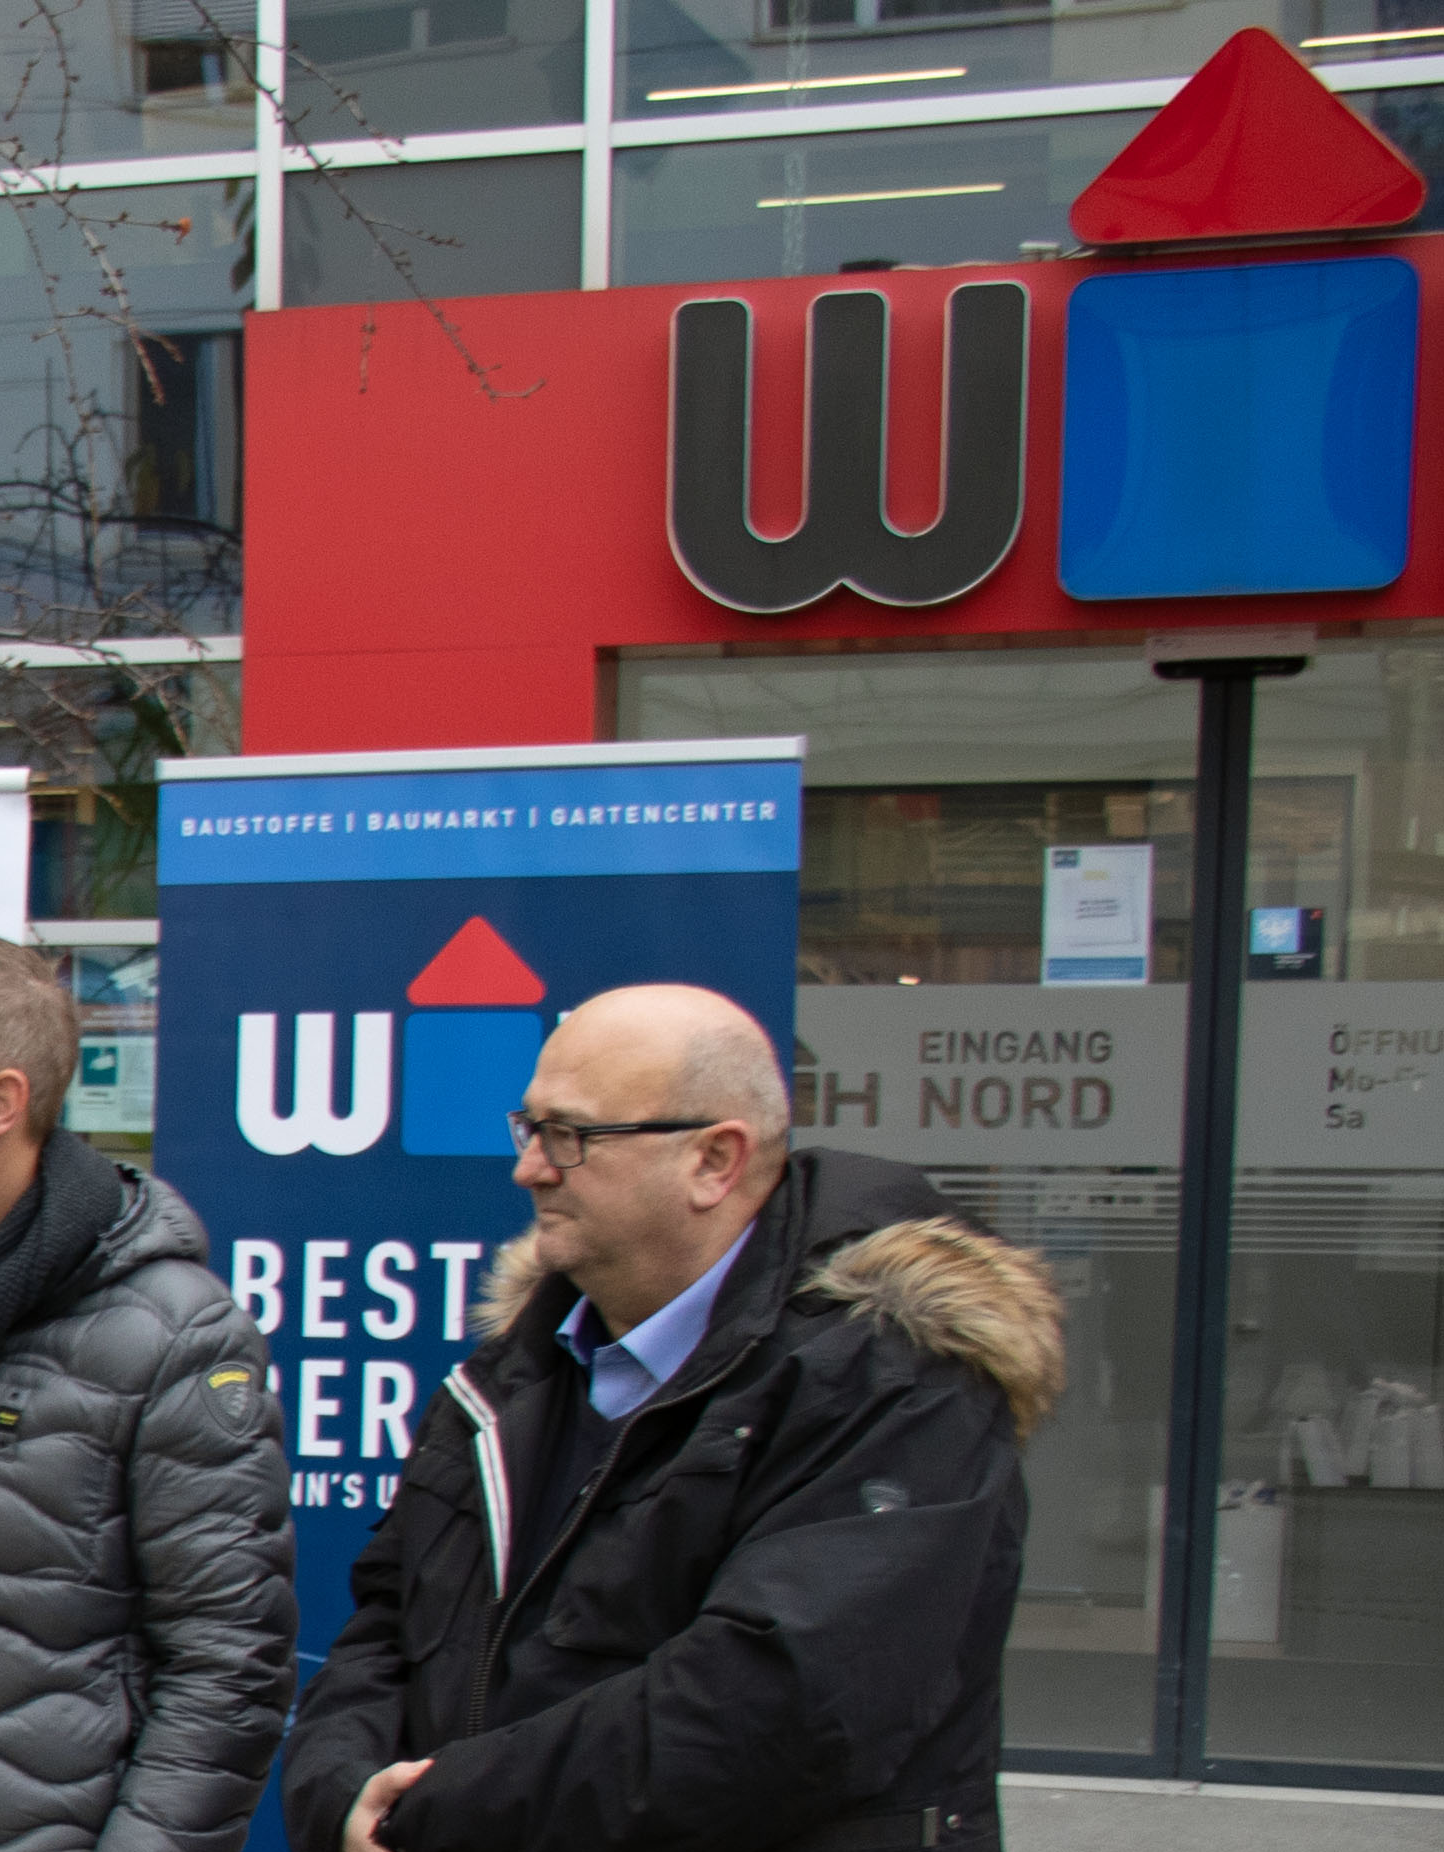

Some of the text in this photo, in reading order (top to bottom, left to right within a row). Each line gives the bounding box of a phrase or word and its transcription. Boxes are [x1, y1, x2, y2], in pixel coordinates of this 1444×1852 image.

[181, 801, 777, 837] BAUSTOFFE BAUMARKT GARTENCENTER
[918, 1029, 1114, 1065] EINGANG
[918, 1074, 1114, 1130] NORD
[1325, 1103, 1365, 1130] Sa
[231, 1239, 512, 1341] BEST
